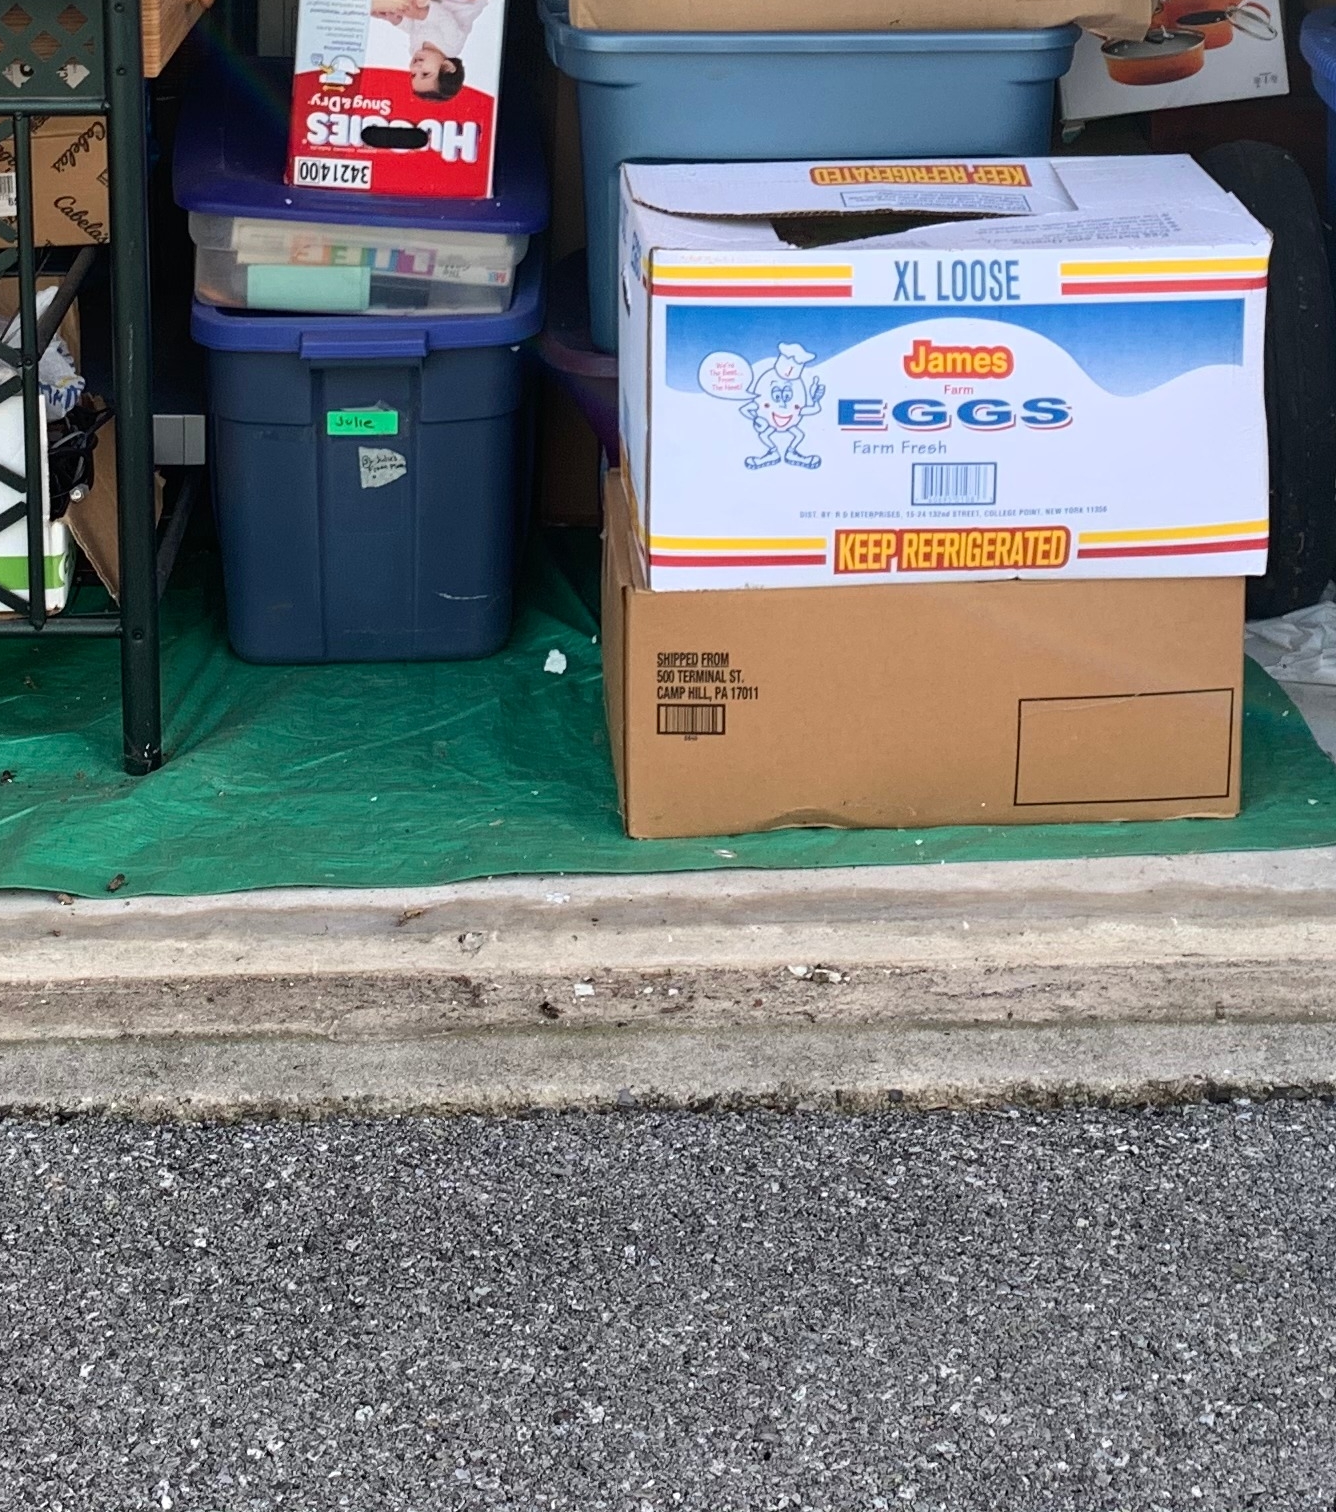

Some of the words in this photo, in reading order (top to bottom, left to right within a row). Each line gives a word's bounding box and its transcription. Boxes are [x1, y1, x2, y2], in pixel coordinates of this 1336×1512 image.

[813, 165, 968, 187] REFRIGERATED
[970, 165, 1027, 187] KEEP
[54, 195, 111, 244] Cabela's
[894, 260, 925, 301] XL
[935, 258, 1021, 301] LOOSE
[907, 343, 1011, 378] James
[943, 383, 975, 396] Farm
[335, 415, 376, 429] Julie
[837, 396, 1075, 434] EGGS
[851, 439, 895, 456] Farm
[900, 438, 948, 456] Fresh
[983, 509, 1017, 518] COLLEGE
[1044, 507, 1062, 516] NEW
[1064, 506, 1084, 515] YORK
[838, 530, 897, 571] KEEP
[901, 529, 1067, 570] REFRIGERATED
[656, 651, 698, 668] SHIPPED
[701, 651, 730, 668] FROM
[656, 669, 675, 684] 500
[677, 669, 727, 684] TERMINAL
[729, 669, 745, 684] ST.
[656, 686, 686, 700] CAMP
[688, 686, 713, 703] HILL,
[715, 686, 729, 700] PA
[731, 686, 759, 700] 17011
